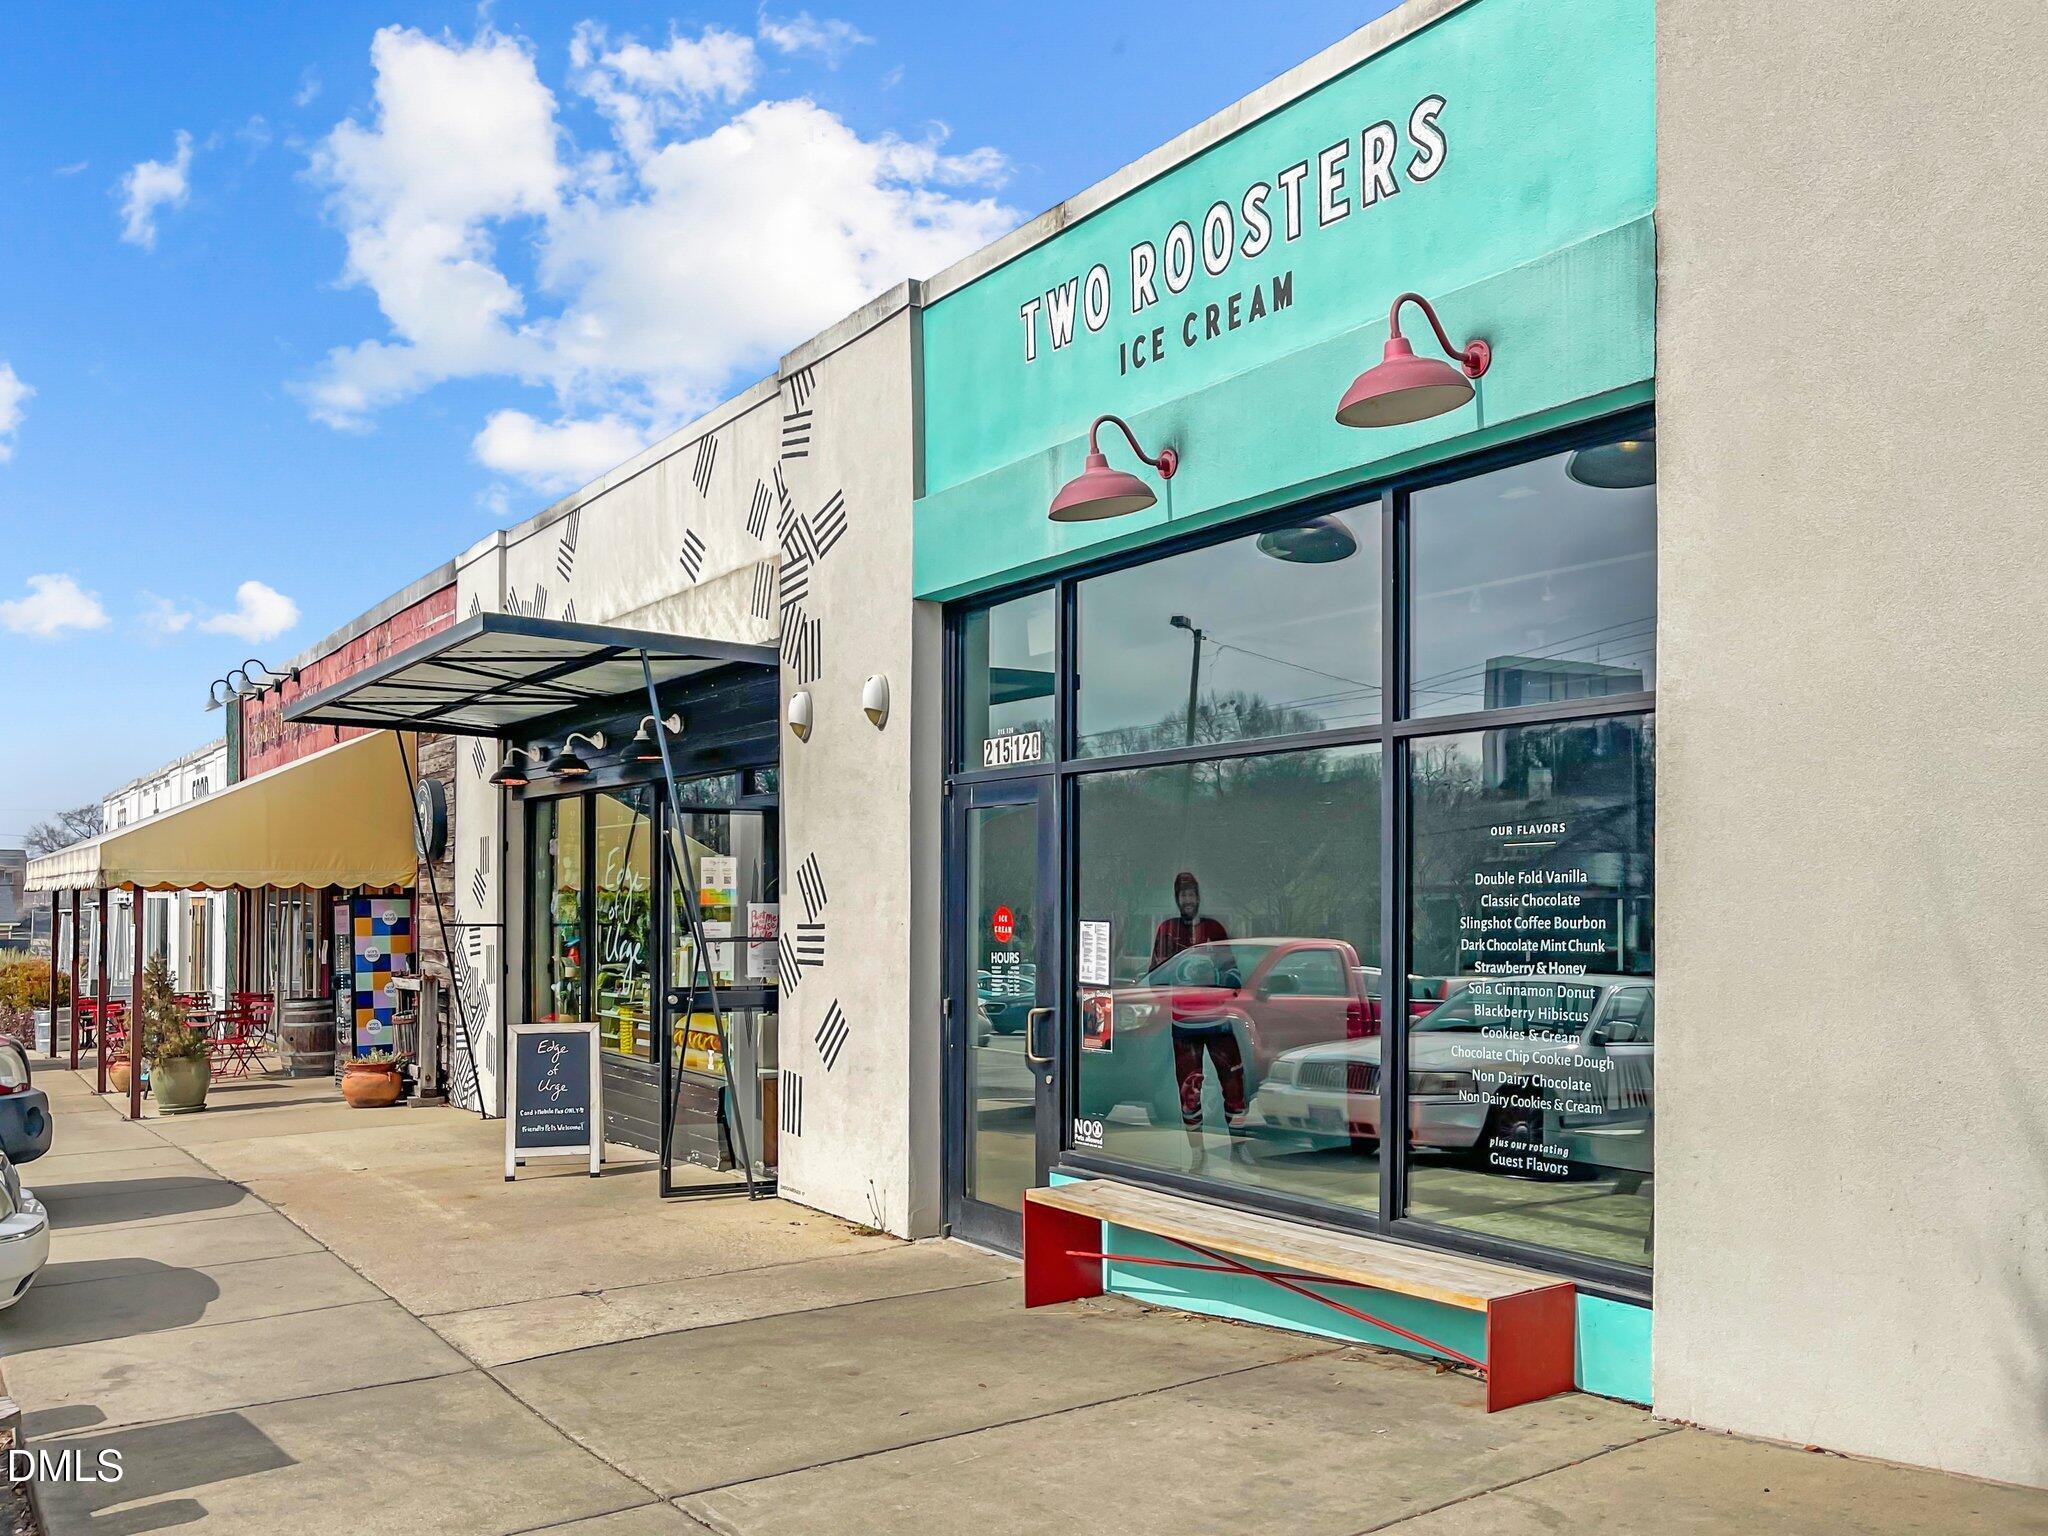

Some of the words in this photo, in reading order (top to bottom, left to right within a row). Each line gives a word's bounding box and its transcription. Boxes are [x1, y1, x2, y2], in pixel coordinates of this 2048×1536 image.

[1019, 262, 1111, 364] TWO
[1130, 93, 1449, 314] ROOSTERS
[1120, 325, 1165, 376] ICE
[1182, 270, 1293, 347] CREAM
[1490, 825, 1513, 836] OUR
[1517, 822, 1566, 835] FLAVORS
[1474, 871, 1515, 886] Double
[1518, 870, 1543, 885] Fold
[1545, 869, 1588, 884] Vanilla
[1481, 894, 1519, 907] Classic
[1521, 893, 1580, 906] Chocolate
[998, 915, 1008, 923] ICE
[1460, 916, 1512, 932] Slingshot
[1514, 916, 1551, 930] Coffee
[1554, 916, 1606, 929] Bourbon
[1461, 938, 1485, 951] Dark
[1486, 938, 1539, 952] Chocolate
[1540, 939, 1566, 952] Mint
[1568, 939, 1606, 953] Chunk
[990, 951, 1020, 964] HOURS
[1474, 961, 1535, 976] Strawberry
[1537, 961, 1548, 975] &
[1548, 962, 1587, 977] Honey
[1468, 982, 1492, 995] Sola
[1494, 983, 1553, 998] Cinnamon
[1557, 985, 1595, 1000] Donut
[1474, 1004, 1535, 1021] Blackberry
[1538, 1007, 1589, 1023] Hibiscus
[1481, 1026, 1525, 1041] Cookies
[1528, 1028, 1539, 1041] &
[1541, 1030, 1580, 1045] Cream
[537, 1040, 569, 1063] Edge
[1451, 1045, 1503, 1061] Chocolate
[1505, 1049, 1530, 1065] Chip
[1532, 1051, 1571, 1066] Cookie
[1574, 1054, 1615, 1072] Dough
[547, 1063, 560, 1076] of
[1472, 1069, 1495, 1083] Non
[1498, 1072, 1529, 1089] Dairy
[1532, 1074, 1592, 1092] Chocolate
[538, 1079, 568, 1102] Urge
[1458, 1090, 1480, 1103] Non
[1482, 1093, 1510, 1108] Dairy
[1510, 1095, 1552, 1110] Cookies
[1554, 1098, 1564, 1112] &
[1565, 1100, 1603, 1114] Cream
[1074, 1118, 1092, 1136] NO
[1489, 1137, 1509, 1149] plus
[1510, 1141, 1527, 1151] our
[1529, 1143, 1569, 1158] rotating
[1490, 1153, 1523, 1169] Guest
[1526, 1157, 1569, 1175] Flavors
